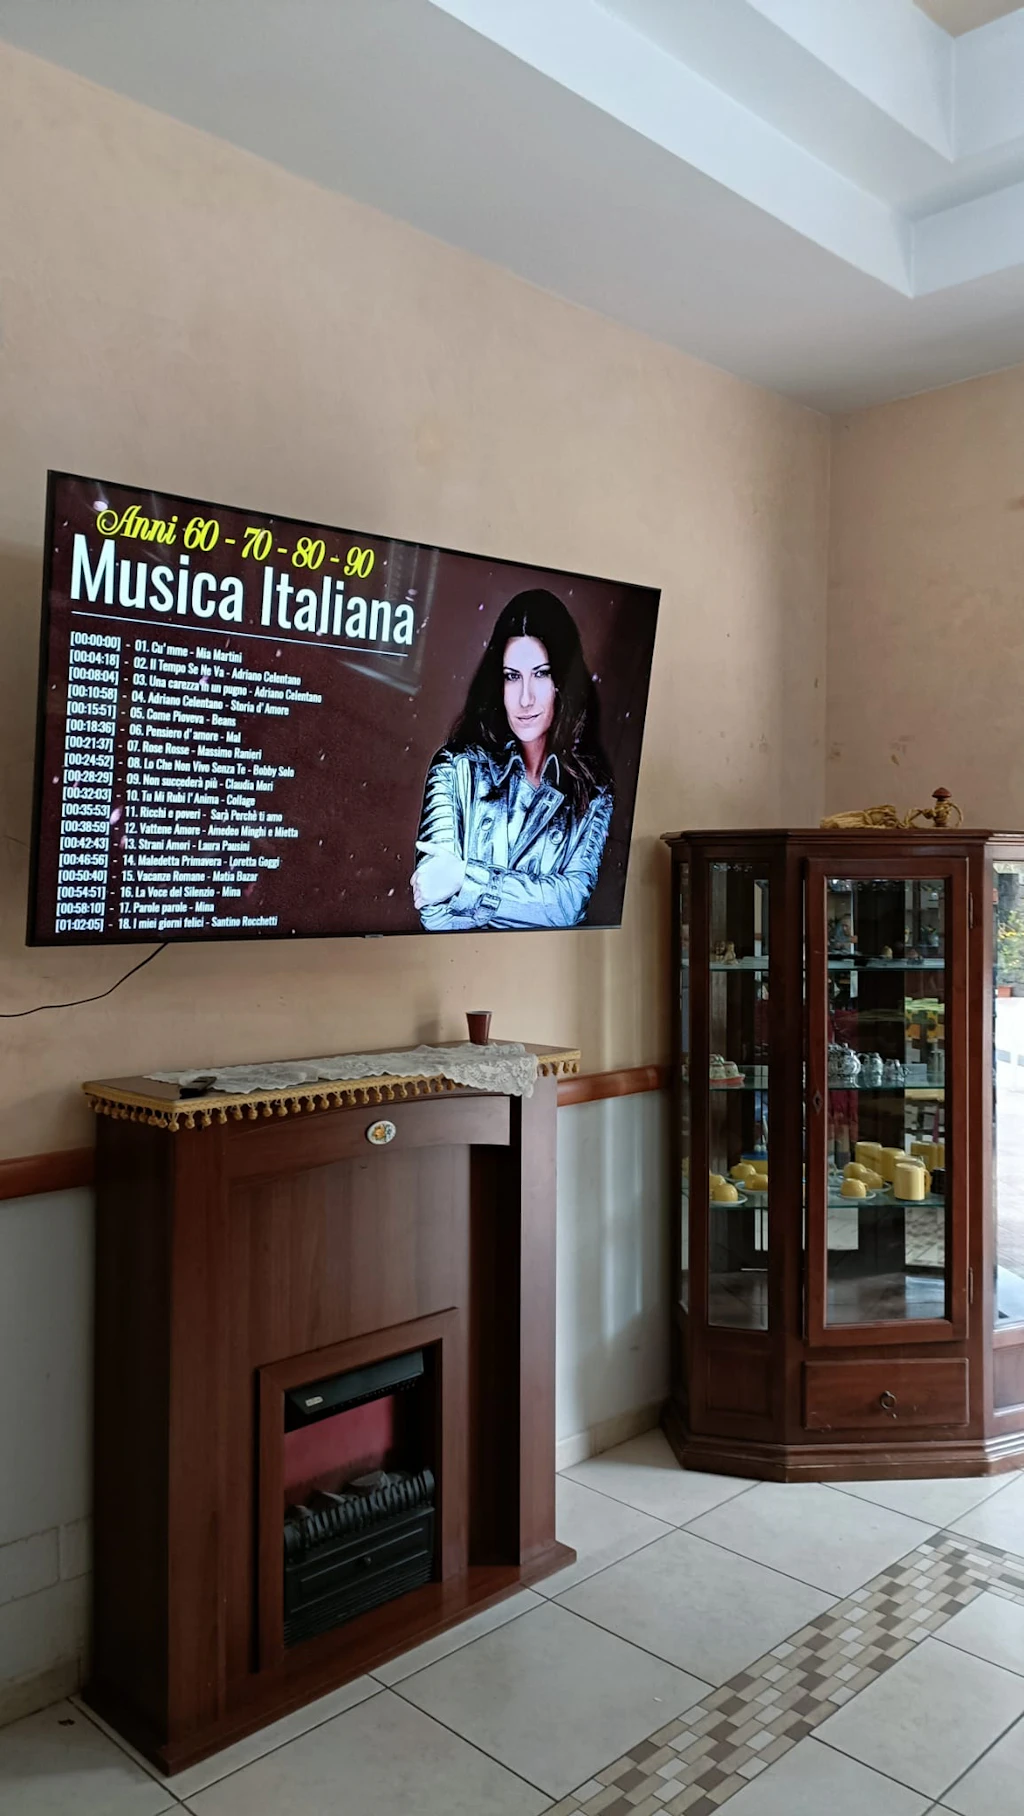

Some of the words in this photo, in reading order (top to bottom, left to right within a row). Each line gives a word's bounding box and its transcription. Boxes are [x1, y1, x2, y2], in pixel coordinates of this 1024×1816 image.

[96, 505, 178, 545] Anni
[183, 517, 220, 552] 60
[241, 526, 273, 561] 70
[291, 536, 326, 570] 80
[343, 546, 375, 579] 90
[70, 533, 244, 622] Musica
[260, 566, 414, 645] Italiana
[70, 630, 121, 652] [00:00:00]
[134, 638, 149, 652] 01.
[195, 646, 212, 660] Mia
[212, 648, 242, 663] Martini
[69, 648, 120, 669] [00:04:18]
[133, 656, 148, 669] 02.
[149, 657, 157, 670] Il
[158, 658, 186, 675] Tempo
[187, 662, 199, 675] Se
[200, 663, 212, 676] Ne
[213, 664, 225, 678] Va
[231, 667, 262, 682] Adriano
[263, 670, 301, 686] Celentano
[68, 665, 119, 686] [00:08:04]
[132, 672, 147, 686] 03.
[148, 674, 166, 688] Una
[167, 680, 199, 691] carezza
[210, 683, 221, 693] un
[222, 684, 247, 697] pugno
[253, 685, 284, 699] Adriano
[284, 688, 322, 703] Celentano
[67, 683, 118, 703] [00:10:58]
[131, 689, 146, 703] 04.
[147, 691, 181, 706] Adriano
[182, 694, 223, 710] Celentano
[230, 698, 255, 713] Storia
[66, 700, 117, 720] [00:15:51]
[129, 706, 145, 719] 05.
[146, 707, 171, 721] Come
[172, 709, 204, 724] Pioveva
[211, 713, 236, 727] Beans
[65, 717, 116, 736] [00:18:36]
[128, 723, 144, 736] 06.
[145, 724, 182, 739] Pensiero
[225, 730, 241, 743] Mal
[64, 734, 113, 753] [00:21:37]
[126, 739, 140, 752] 07.
[142, 740, 163, 754] Rose
[164, 742, 190, 755] Rosse
[196, 744, 233, 758] Massimo
[233, 746, 262, 760] Ranieri
[63, 752, 114, 770] [00:24:52]
[127, 756, 142, 769] 08.
[143, 757, 154, 769] Lo
[155, 758, 172, 770] Che
[173, 759, 191, 772] Non
[192, 760, 210, 773] Vivo
[211, 761, 235, 774] Senza
[236, 762, 246, 775] Te
[252, 763, 277, 778] Bobby
[277, 765, 294, 777] Solo
[63, 768, 113, 786] [00:28:29]
[126, 772, 141, 785] 09.
[142, 773, 160, 786] Non
[204, 776, 218, 791] più
[224, 777, 254, 791] Claudia
[255, 779, 273, 791] Mori
[62, 785, 112, 802] [00:32:03]
[126, 788, 139, 801] 10.
[141, 789, 152, 802] Tu
[153, 790, 165, 802] Mi
[165, 790, 186, 803] Rubi
[226, 793, 256, 808] Collage
[61, 802, 110, 819] [00:35:53]
[125, 805, 138, 817] 11.
[139, 805, 166, 818] Ricchi
[167, 809, 174, 818] e
[174, 808, 201, 821] poveri
[258, 810, 265, 822] ti
[265, 813, 283, 822] amo
[60, 819, 110, 835] [00:38:59]
[124, 821, 137, 834] 12.
[139, 822, 172, 835] Vattene
[173, 823, 201, 835] Amore
[207, 824, 239, 836] Amedeo
[240, 824, 267, 839] Minghi
[267, 828, 273, 837] e
[274, 826, 298, 838] Mietta
[59, 835, 109, 851] [00:42:43]
[123, 836, 136, 849] 13.
[138, 837, 164, 850] Strani
[164, 838, 191, 850] Amori
[197, 839, 220, 851] Laura
[221, 839, 250, 852] Pausini
[58, 853, 108, 868] [00:46:56]
[122, 854, 136, 866] 14.
[137, 854, 180, 866] Maledetta
[180, 854, 222, 866] Primavera
[228, 855, 257, 870] Loretta
[257, 855, 280, 869] Goggi
[57, 869, 107, 884] [00:50:40]
[121, 869, 135, 881] 15.
[136, 869, 171, 881] Vacanze
[172, 870, 205, 882] Romane
[211, 870, 235, 881] Matia
[235, 870, 258, 882] Bazar
[56, 885, 106, 900] [00:54:51]
[120, 885, 133, 898] 16.
[134, 886, 146, 898] La
[147, 885, 168, 897] Voce
[168, 885, 182, 897] del
[183, 885, 215, 897] Silenzio
[221, 885, 241, 897] Mina
[55, 901, 105, 917] [00:58:10]
[119, 901, 131, 913] 17.
[132, 901, 160, 913] Parole
[161, 901, 187, 915] parole
[194, 901, 214, 912] Mina
[54, 918, 104, 933] [01:02:05]
[118, 917, 131, 929] 18.
[138, 917, 157, 929] miei
[158, 917, 182, 930] giorni
[183, 916, 204, 928] felici
[211, 916, 241, 927] Santino
[241, 915, 278, 926] Rocchetti
